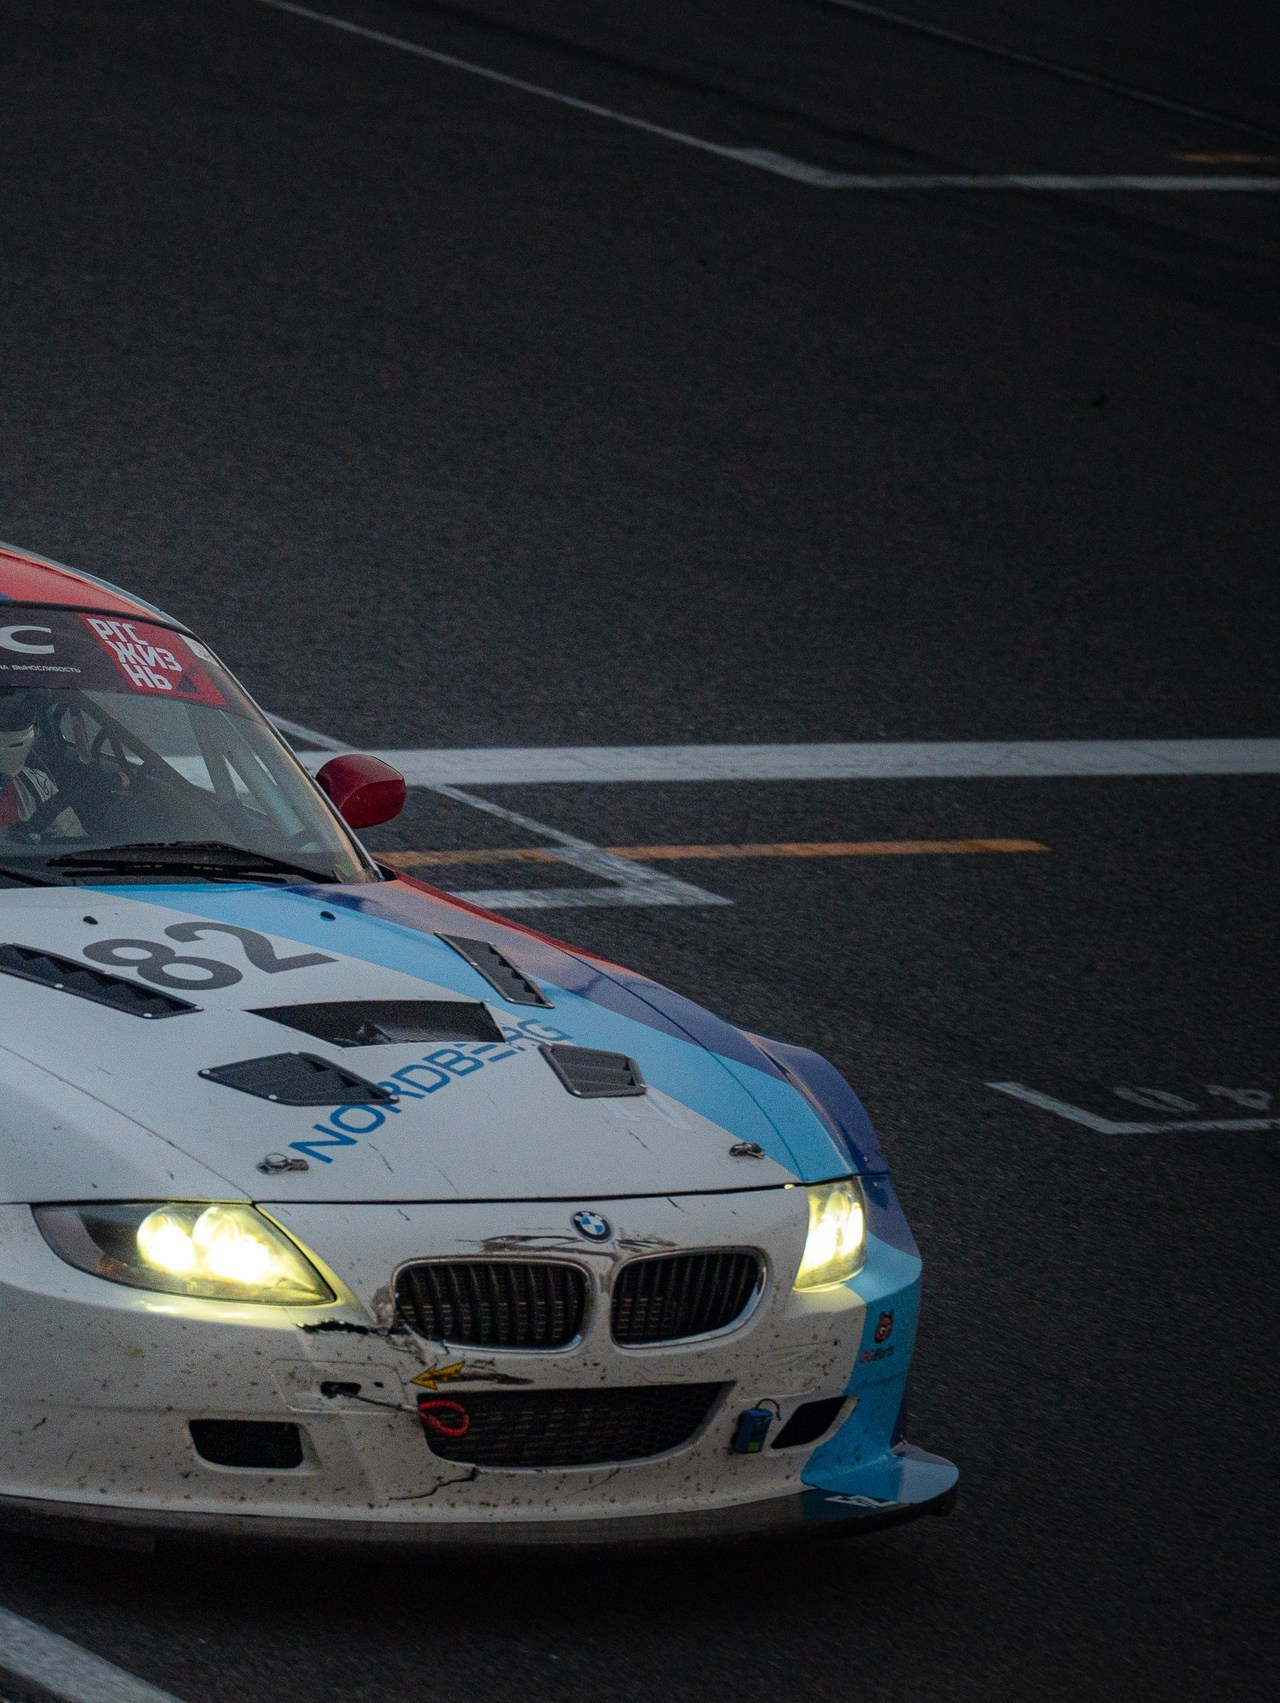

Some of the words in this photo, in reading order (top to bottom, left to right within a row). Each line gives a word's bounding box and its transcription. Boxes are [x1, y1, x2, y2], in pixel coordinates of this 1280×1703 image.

[86, 618, 149, 645] РГС
[105, 640, 183, 672] ЖИЗ
[121, 663, 173, 690] НЬ
[82, 921, 340, 991] 82
[288, 1018, 574, 1164] NORDBERG
